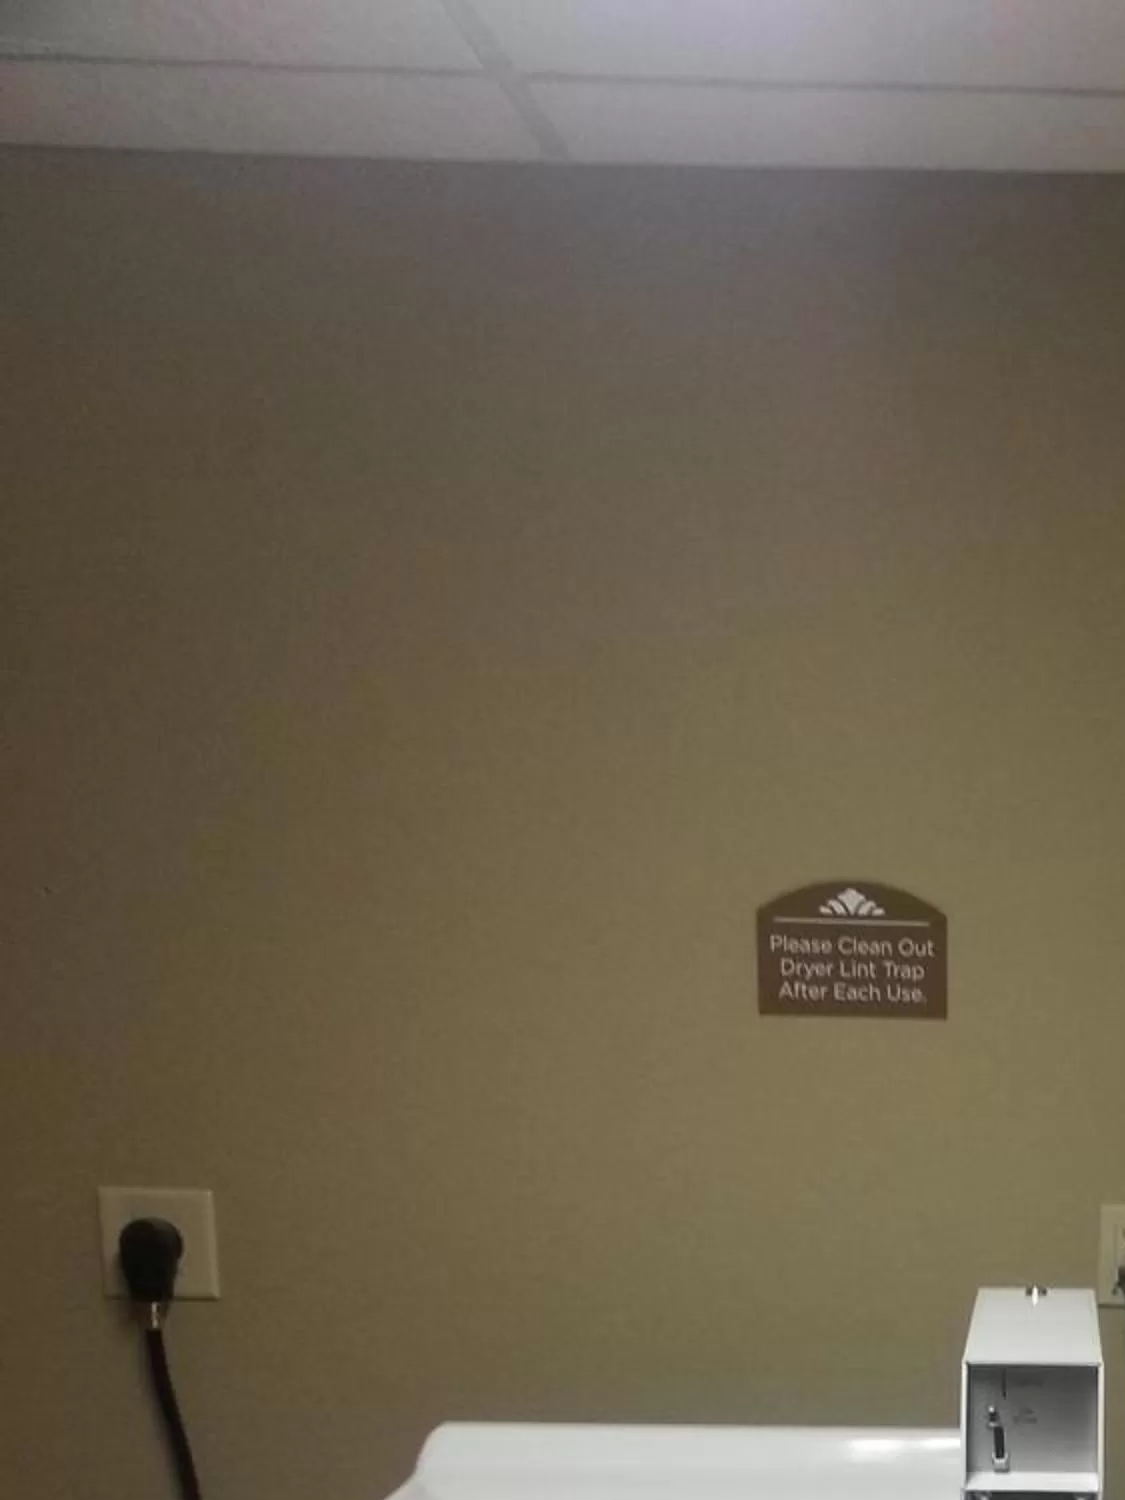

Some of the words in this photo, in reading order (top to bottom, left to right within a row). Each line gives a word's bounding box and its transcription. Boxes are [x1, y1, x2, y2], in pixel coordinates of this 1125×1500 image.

[769, 934, 833, 955] Please
[838, 936, 892, 956] Clean
[898, 938, 936, 957] Out
[781, 957, 833, 981] Dryer
[840, 960, 877, 979] Lint
[883, 960, 925, 981] Trap
[779, 981, 828, 1000] After
[834, 982, 881, 1001] Each
